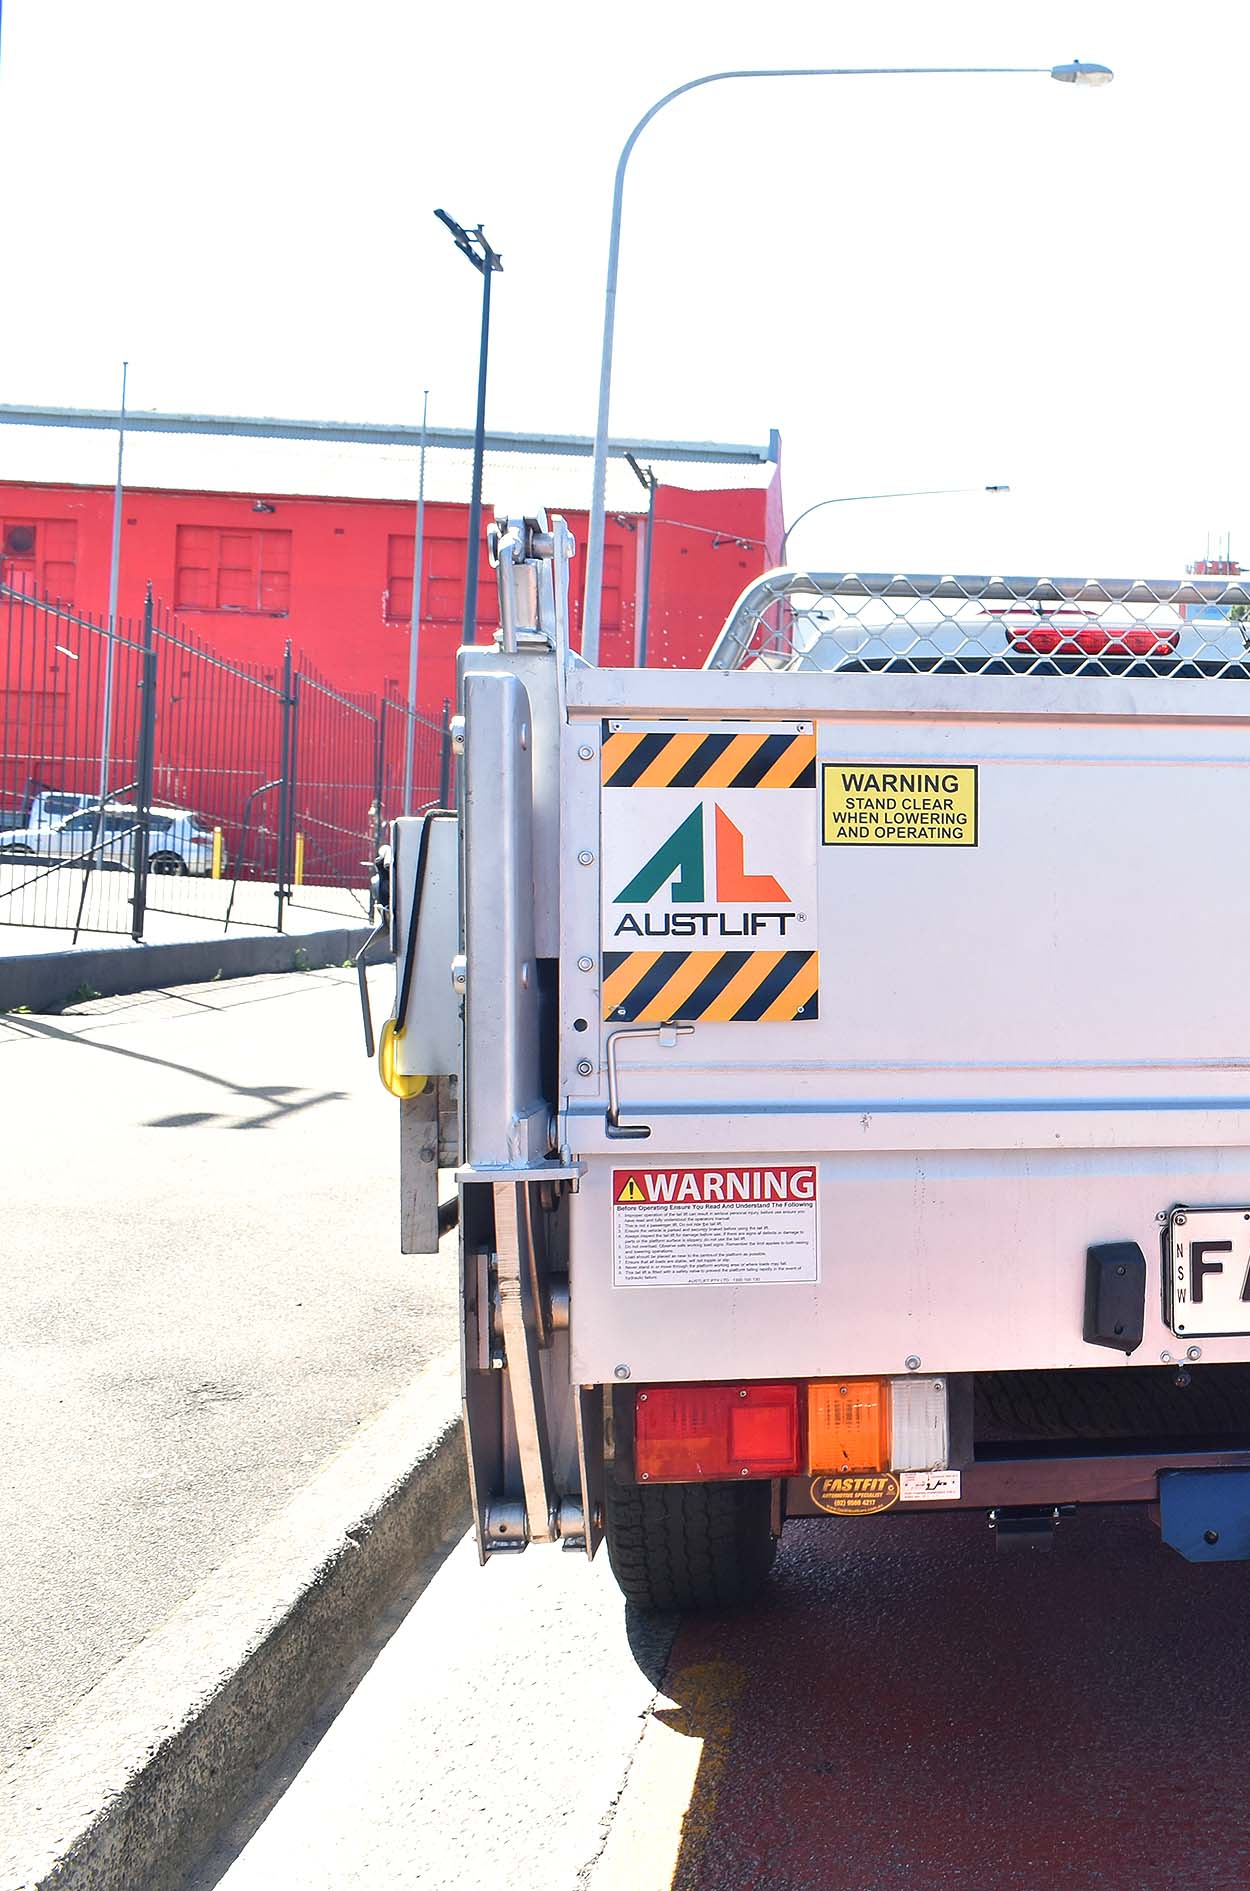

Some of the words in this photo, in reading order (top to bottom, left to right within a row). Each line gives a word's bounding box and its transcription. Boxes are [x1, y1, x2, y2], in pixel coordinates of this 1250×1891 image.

[842, 773, 959, 793] WARNING
[845, 797, 897, 810] STAND
[901, 798, 954, 811] CLEAR
[832, 811, 879, 824] WHEN
[884, 812, 967, 825] LOWERING
[836, 826, 870, 838] AND
[874, 826, 964, 839] OPERATING
[613, 912, 797, 937] AUSTLIFT
[643, 1170, 815, 1202] WARNING
[822, 1478, 889, 1491] FASTFIT
